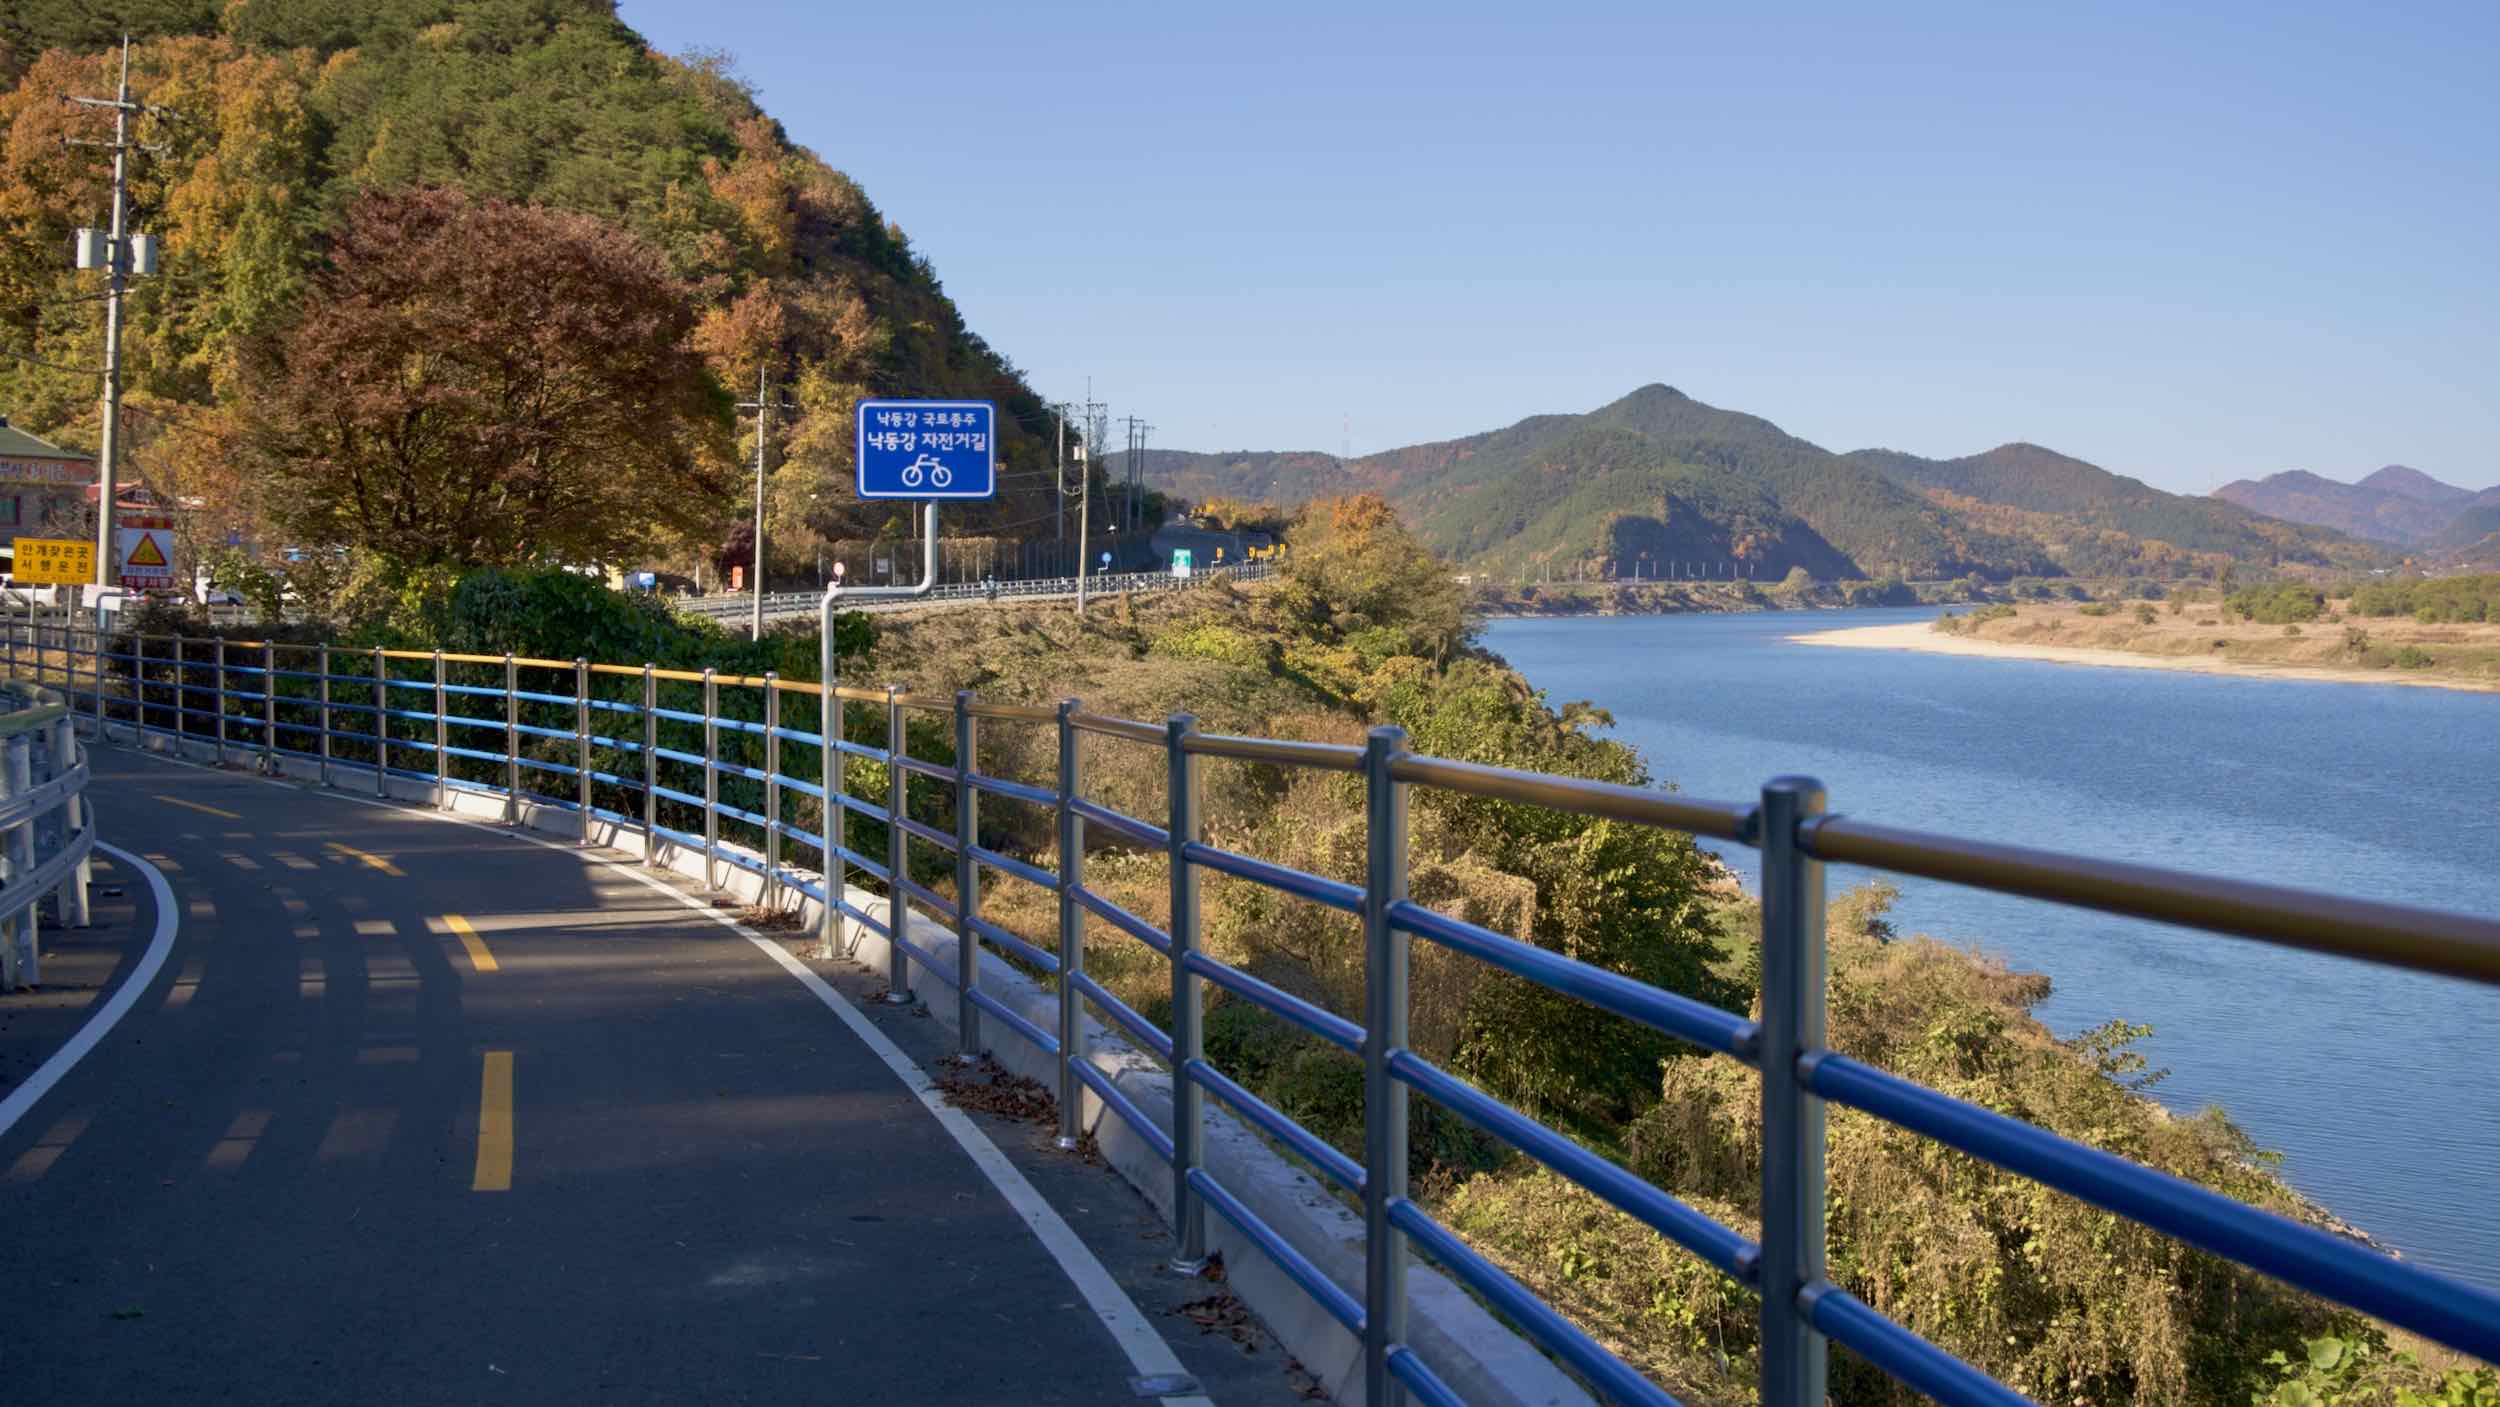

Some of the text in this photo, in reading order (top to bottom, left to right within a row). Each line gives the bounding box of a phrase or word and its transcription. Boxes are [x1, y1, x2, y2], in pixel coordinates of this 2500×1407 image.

[877, 411, 976, 428] 낙동강 국토종주
[868, 431, 986, 452] 낙동강 자전거길
